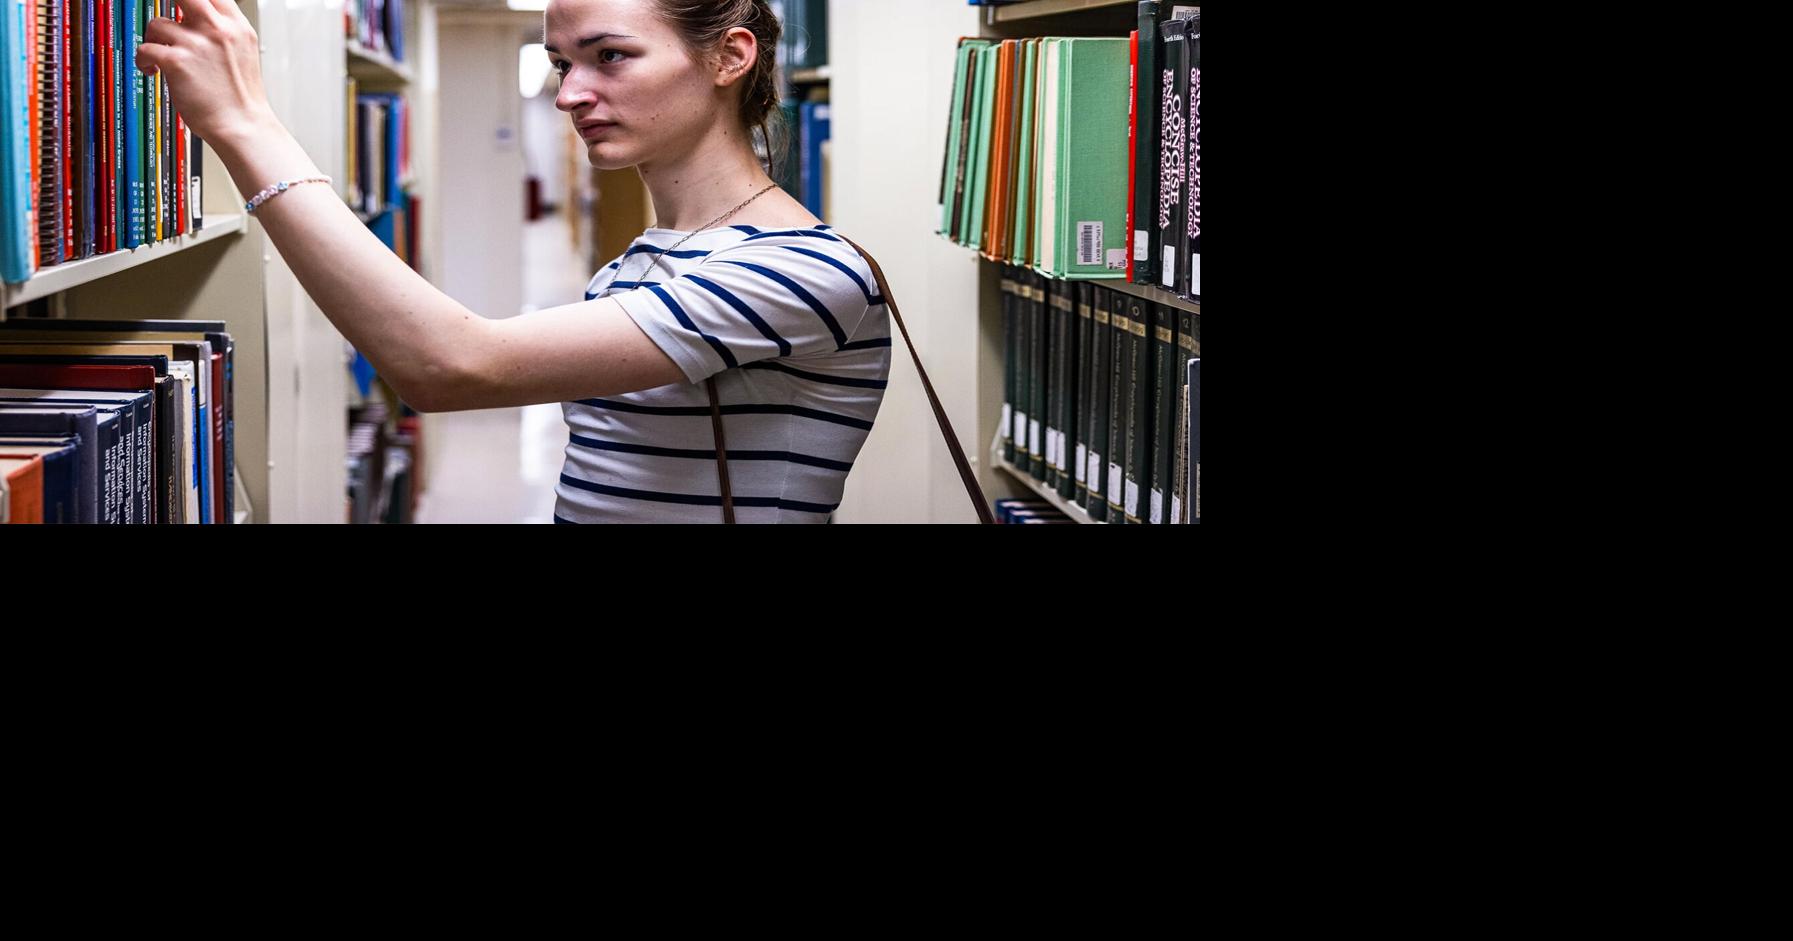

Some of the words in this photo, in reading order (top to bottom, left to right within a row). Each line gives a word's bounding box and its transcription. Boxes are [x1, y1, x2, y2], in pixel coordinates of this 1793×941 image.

[1191, 68, 1197, 85] OF
[1163, 69, 1174, 230] ENCYCLOPEDIA
[1171, 94, 1181, 205] CONCISE
[1190, 142, 1196, 152] &
